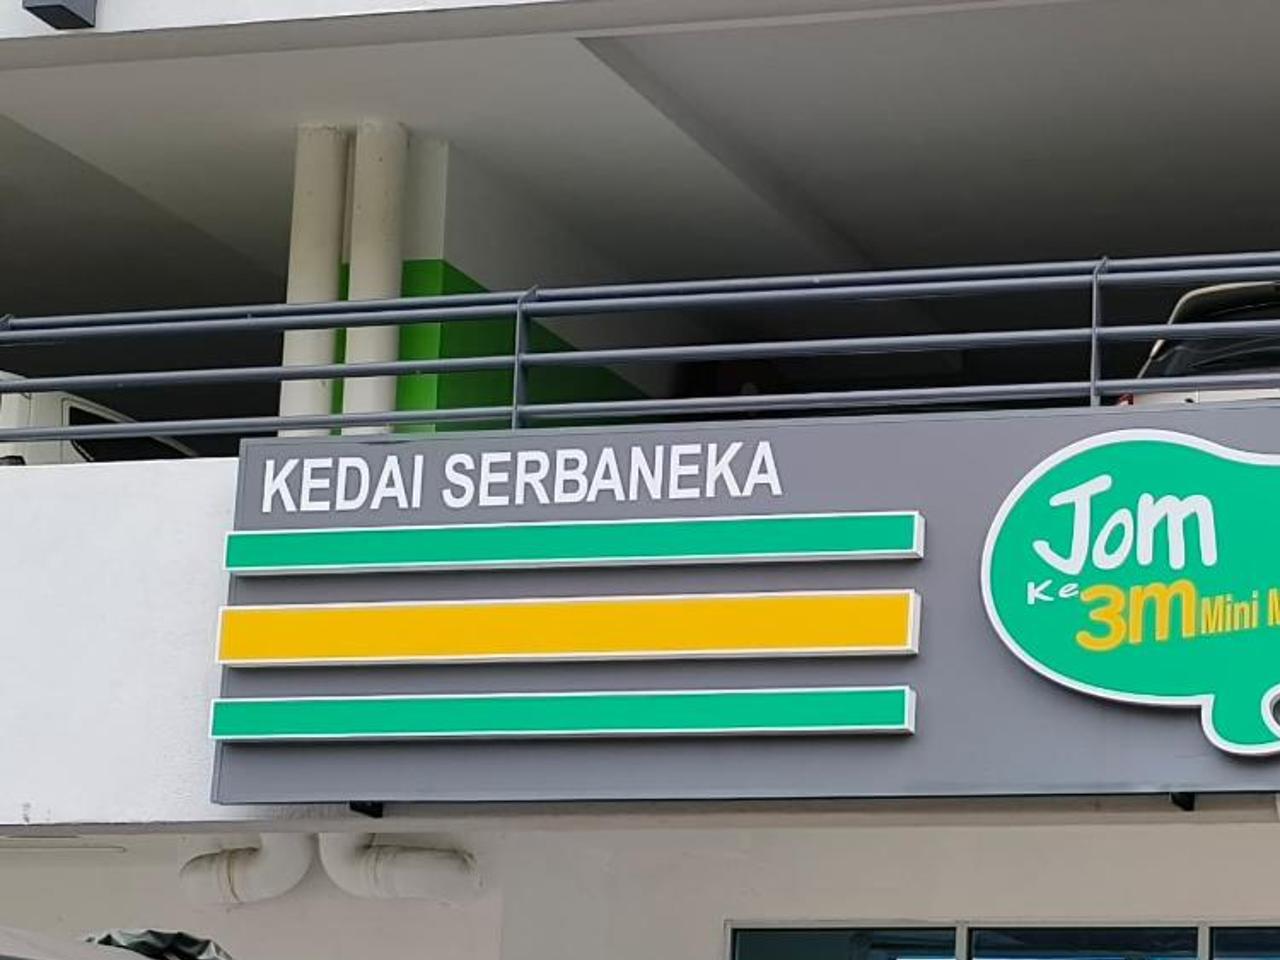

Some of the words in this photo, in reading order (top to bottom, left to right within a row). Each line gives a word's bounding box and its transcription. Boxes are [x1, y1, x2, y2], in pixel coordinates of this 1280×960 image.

[262, 455, 424, 513] KEDAI
[441, 440, 783, 507] SERBANEKA
[1032, 474, 1217, 575] Jom
[1027, 580, 1079, 605] Ke
[1075, 579, 1197, 652] 3m
[1200, 590, 1258, 635] Mini
